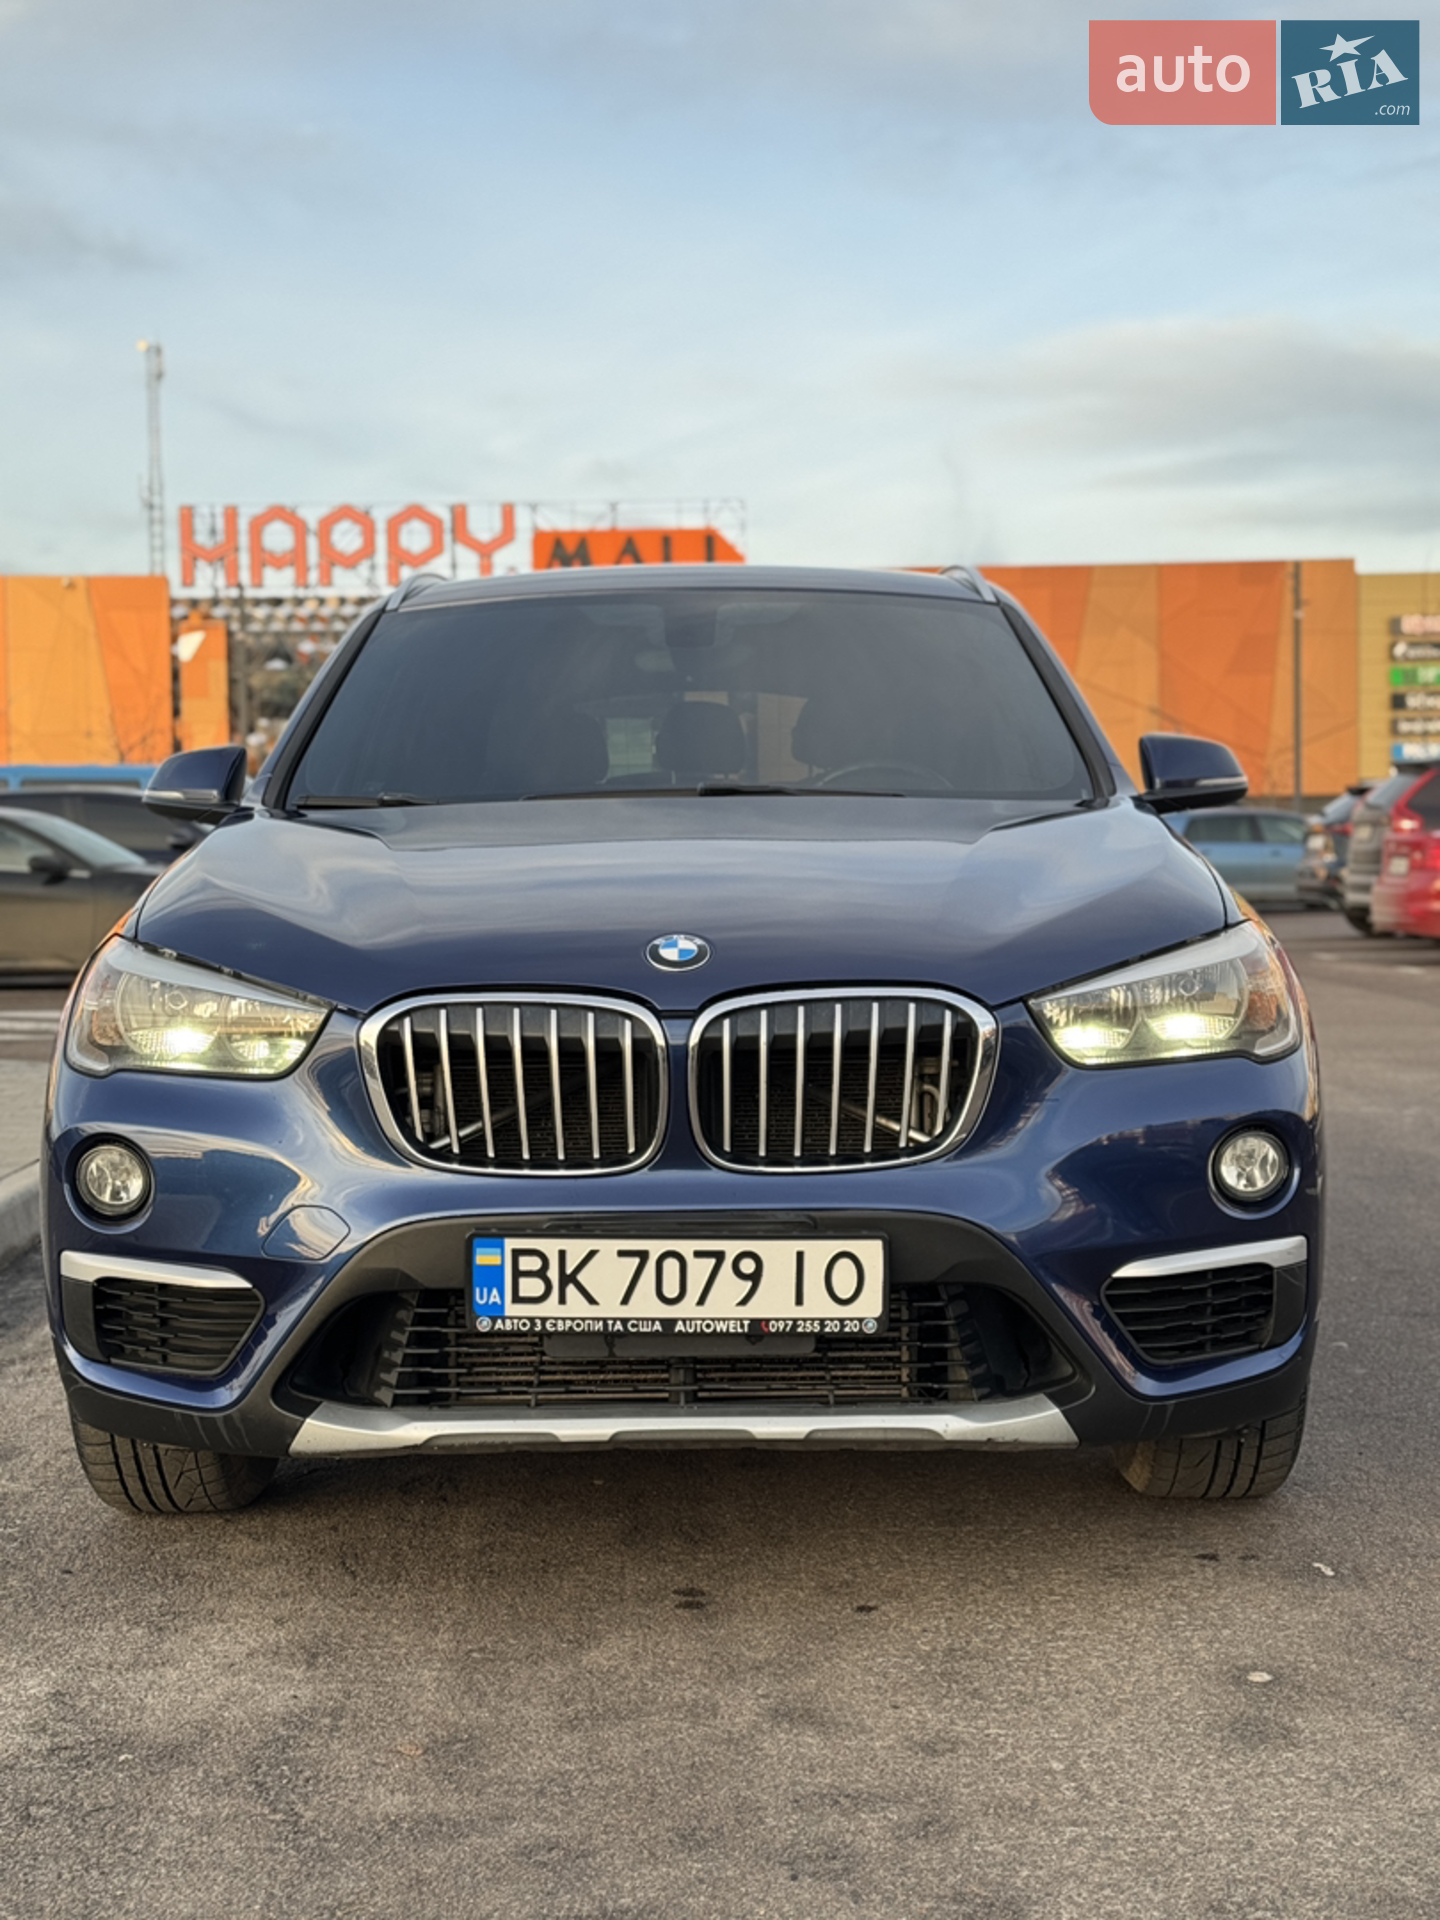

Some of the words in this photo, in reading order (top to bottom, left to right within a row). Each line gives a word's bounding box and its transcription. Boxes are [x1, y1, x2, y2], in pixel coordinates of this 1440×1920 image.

[178, 503, 515, 588] HAPPY
[510, 1247, 601, 1306] BK
[616, 1248, 765, 1308] 7079
[794, 1249, 866, 1308] IO
[475, 1286, 502, 1306] UA
[493, 1318, 531, 1332] АВТО
[545, 1319, 604, 1333] ЄВРОПИ
[606, 1319, 625, 1333] ТА
[626, 1319, 663, 1333] США
[674, 1319, 751, 1334] AUTOWELT
[768, 1319, 793, 1334] 097
[796, 1319, 821, 1334] 255
[823, 1319, 841, 1334] 20
[843, 1319, 860, 1334] 20
